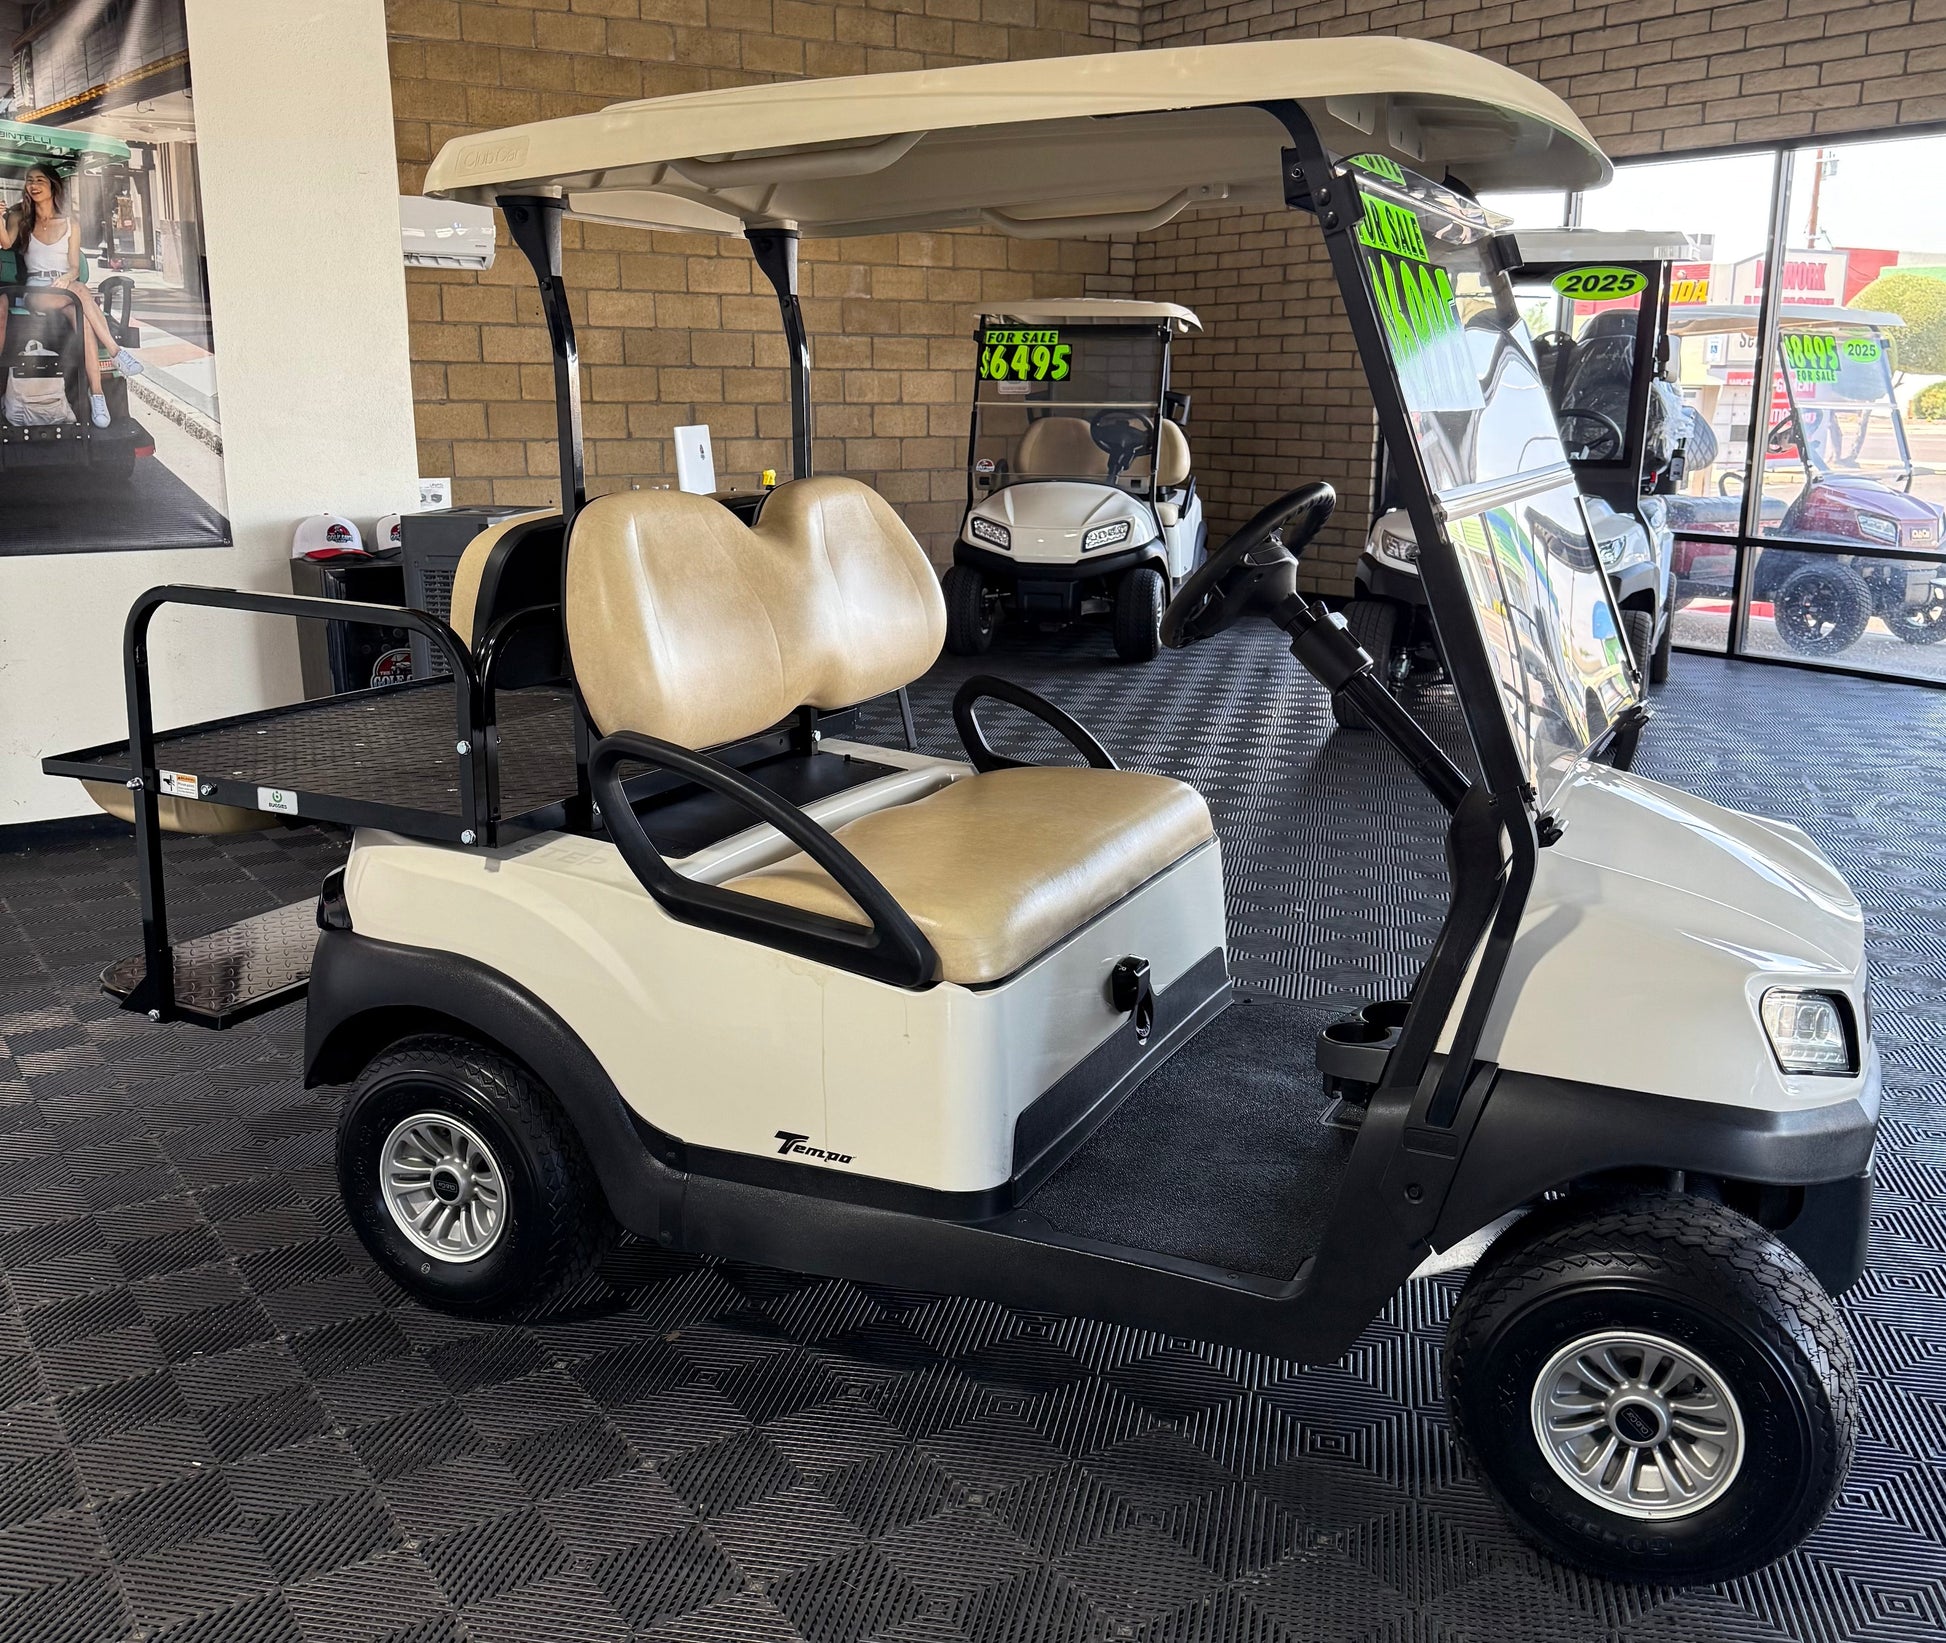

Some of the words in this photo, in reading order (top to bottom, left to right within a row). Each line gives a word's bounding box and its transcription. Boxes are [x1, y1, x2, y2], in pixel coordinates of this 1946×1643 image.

[1359, 200, 1389, 248] OR
[1385, 206, 1428, 259] SALE
[1562, 273, 1637, 293] 2025
[987, 332, 1015, 344] FOR
[1021, 332, 1057, 344] SALE
[1847, 343, 1876, 357] 2025
[980, 344, 1071, 380] $6495
[1784, 334, 1839, 370] $8495
[1797, 370, 1814, 381] FOR
[1815, 370, 1837, 381] SALE
[774, 1130, 853, 1164] Tempo
